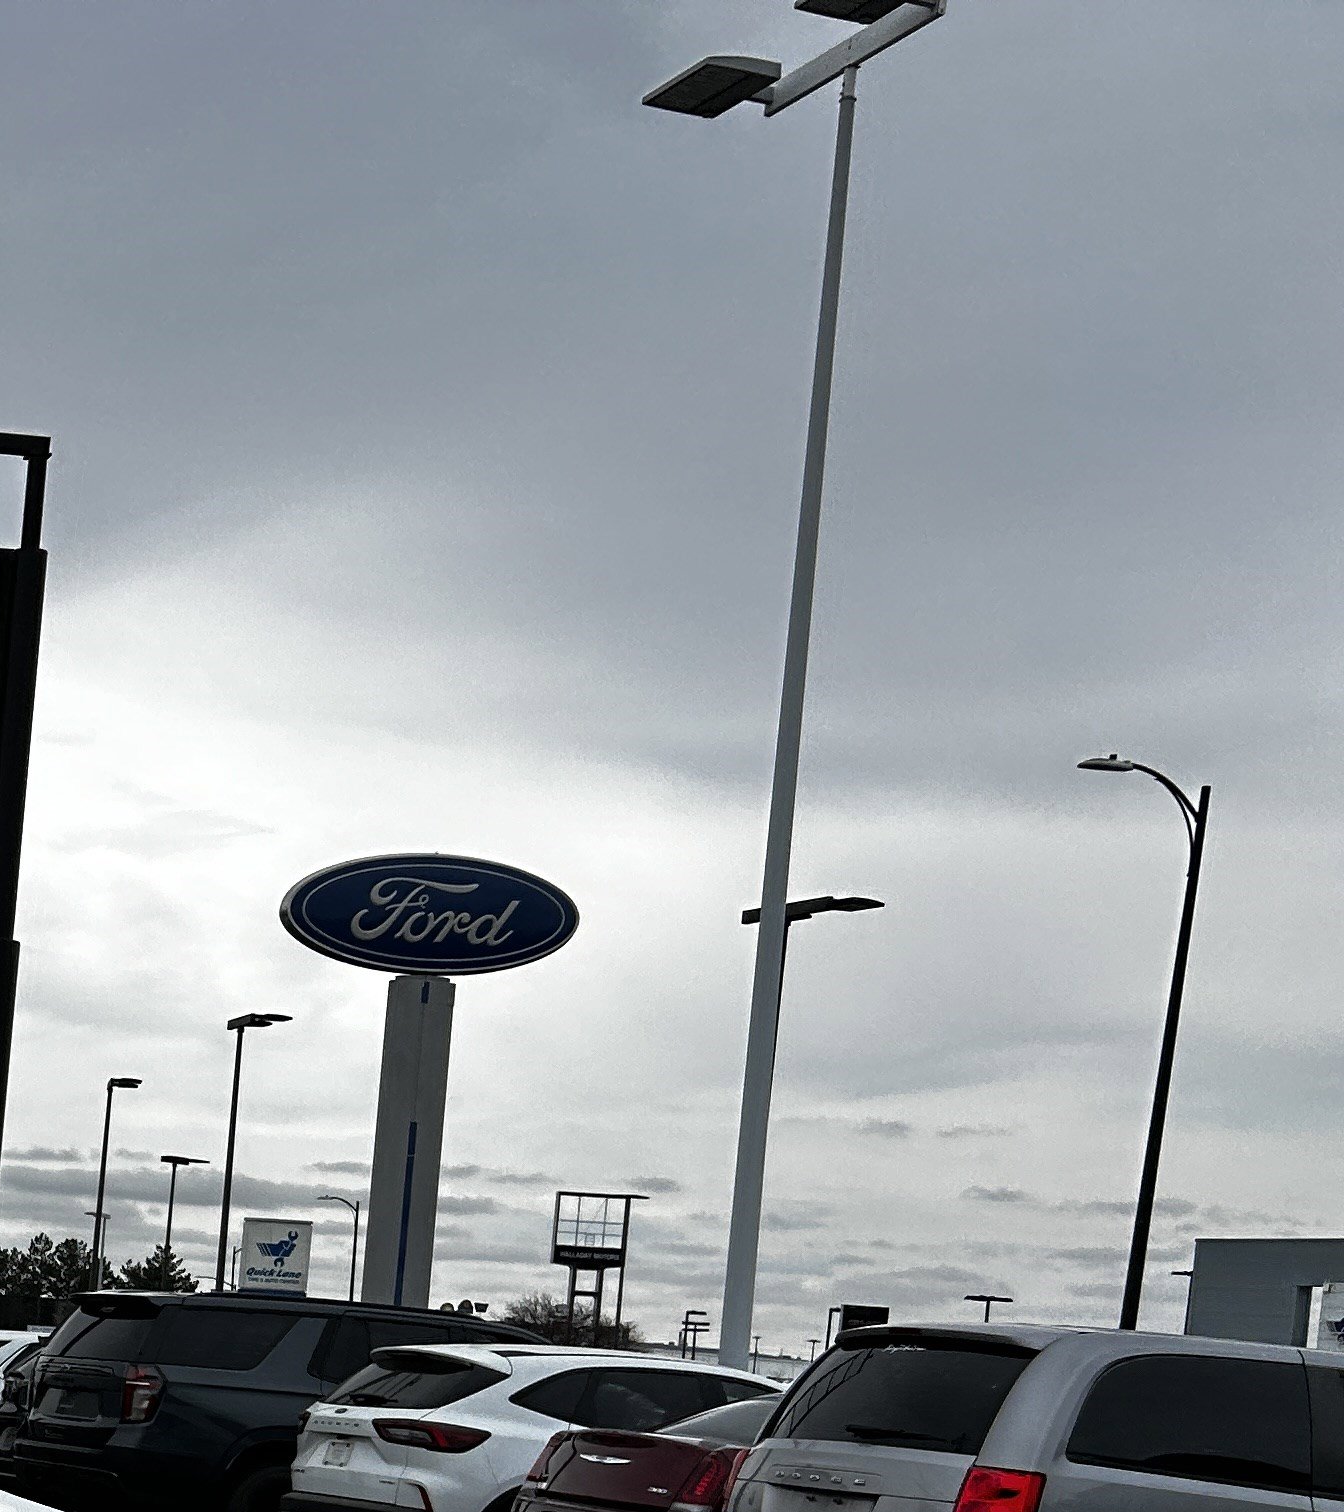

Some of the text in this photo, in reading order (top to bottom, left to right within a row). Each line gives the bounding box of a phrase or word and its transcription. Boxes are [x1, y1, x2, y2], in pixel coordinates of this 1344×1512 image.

[350, 876, 519, 946] Ford
[247, 1267, 301, 1278] Quick Lane
